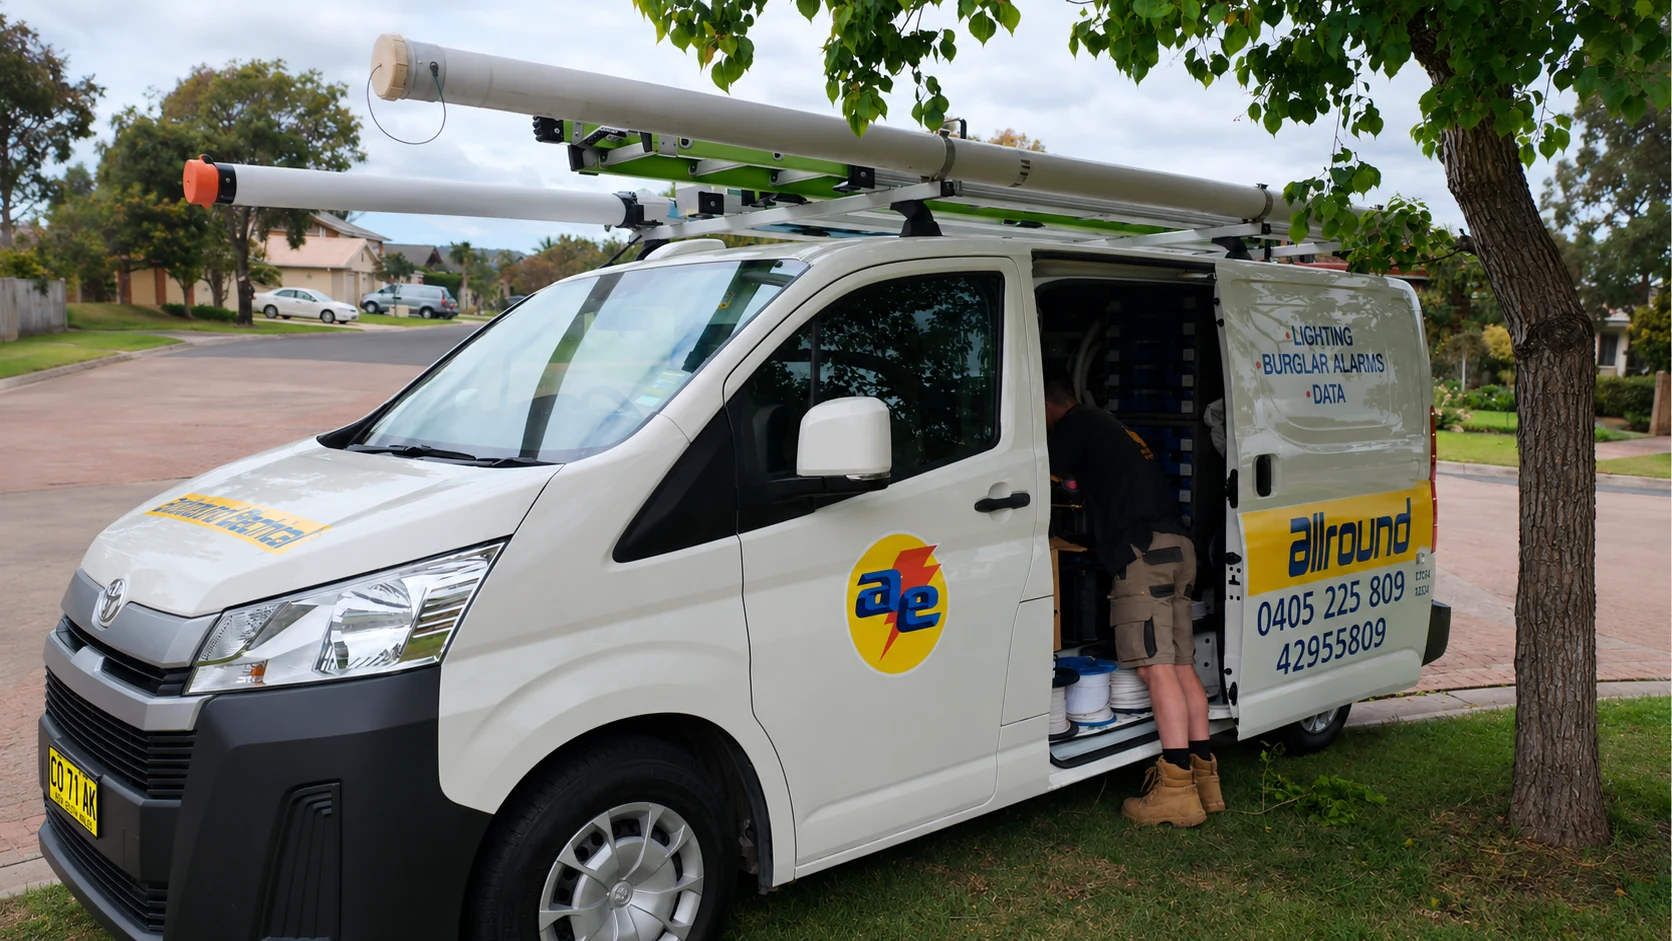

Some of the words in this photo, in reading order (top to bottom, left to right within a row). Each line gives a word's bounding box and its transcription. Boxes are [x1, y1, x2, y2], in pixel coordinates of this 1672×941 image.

[1291, 325, 1353, 346] LIGHTING
[1262, 353, 1330, 375] BURGLAR
[1333, 353, 1385, 374] ALARMS
[1312, 383, 1346, 404] DATA
[1288, 497, 1411, 578] allround
[1257, 591, 1314, 637] 0405
[1323, 579, 1360, 619] 225
[1369, 570, 1405, 608] 809
[1276, 617, 1387, 675] 42955809
[67, 767, 78, 806] 71
[82, 781, 96, 821] AK
